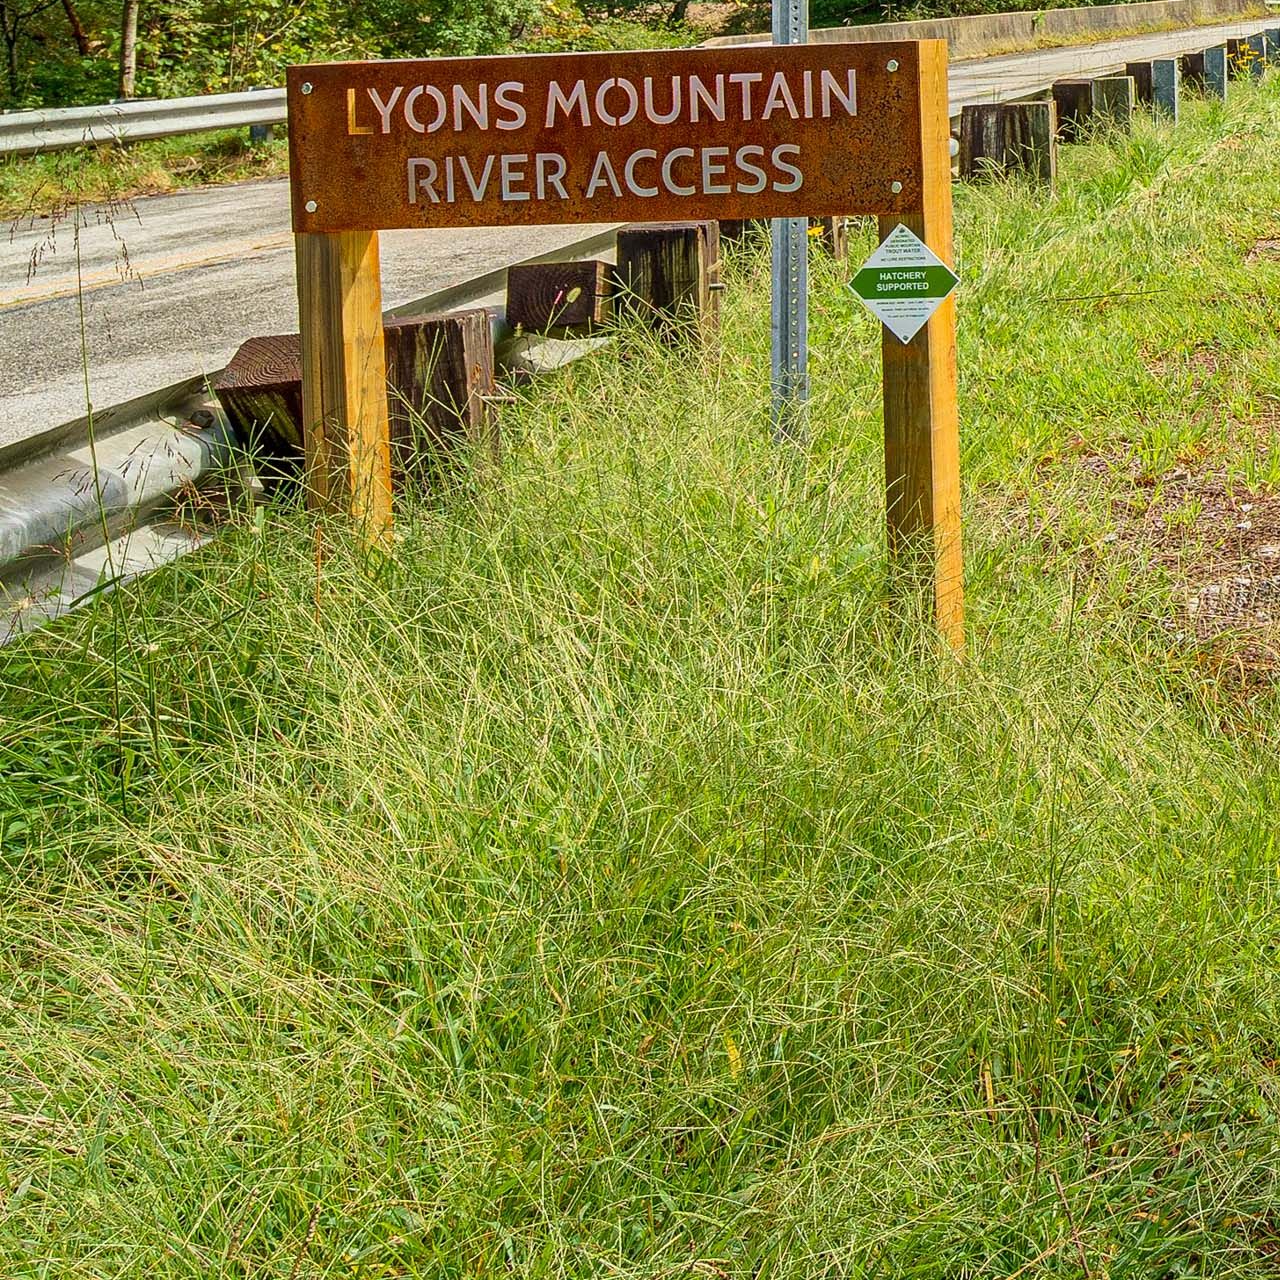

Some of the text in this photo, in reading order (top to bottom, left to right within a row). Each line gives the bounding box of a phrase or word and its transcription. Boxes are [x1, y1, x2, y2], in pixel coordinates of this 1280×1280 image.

[346, 69, 857, 135] LYONS MOUNTAIN
[407, 144, 803, 203] RIVER ACCESS
[876, 282, 929, 291] SUPPORTED
[879, 272, 927, 280] HATCHERY
